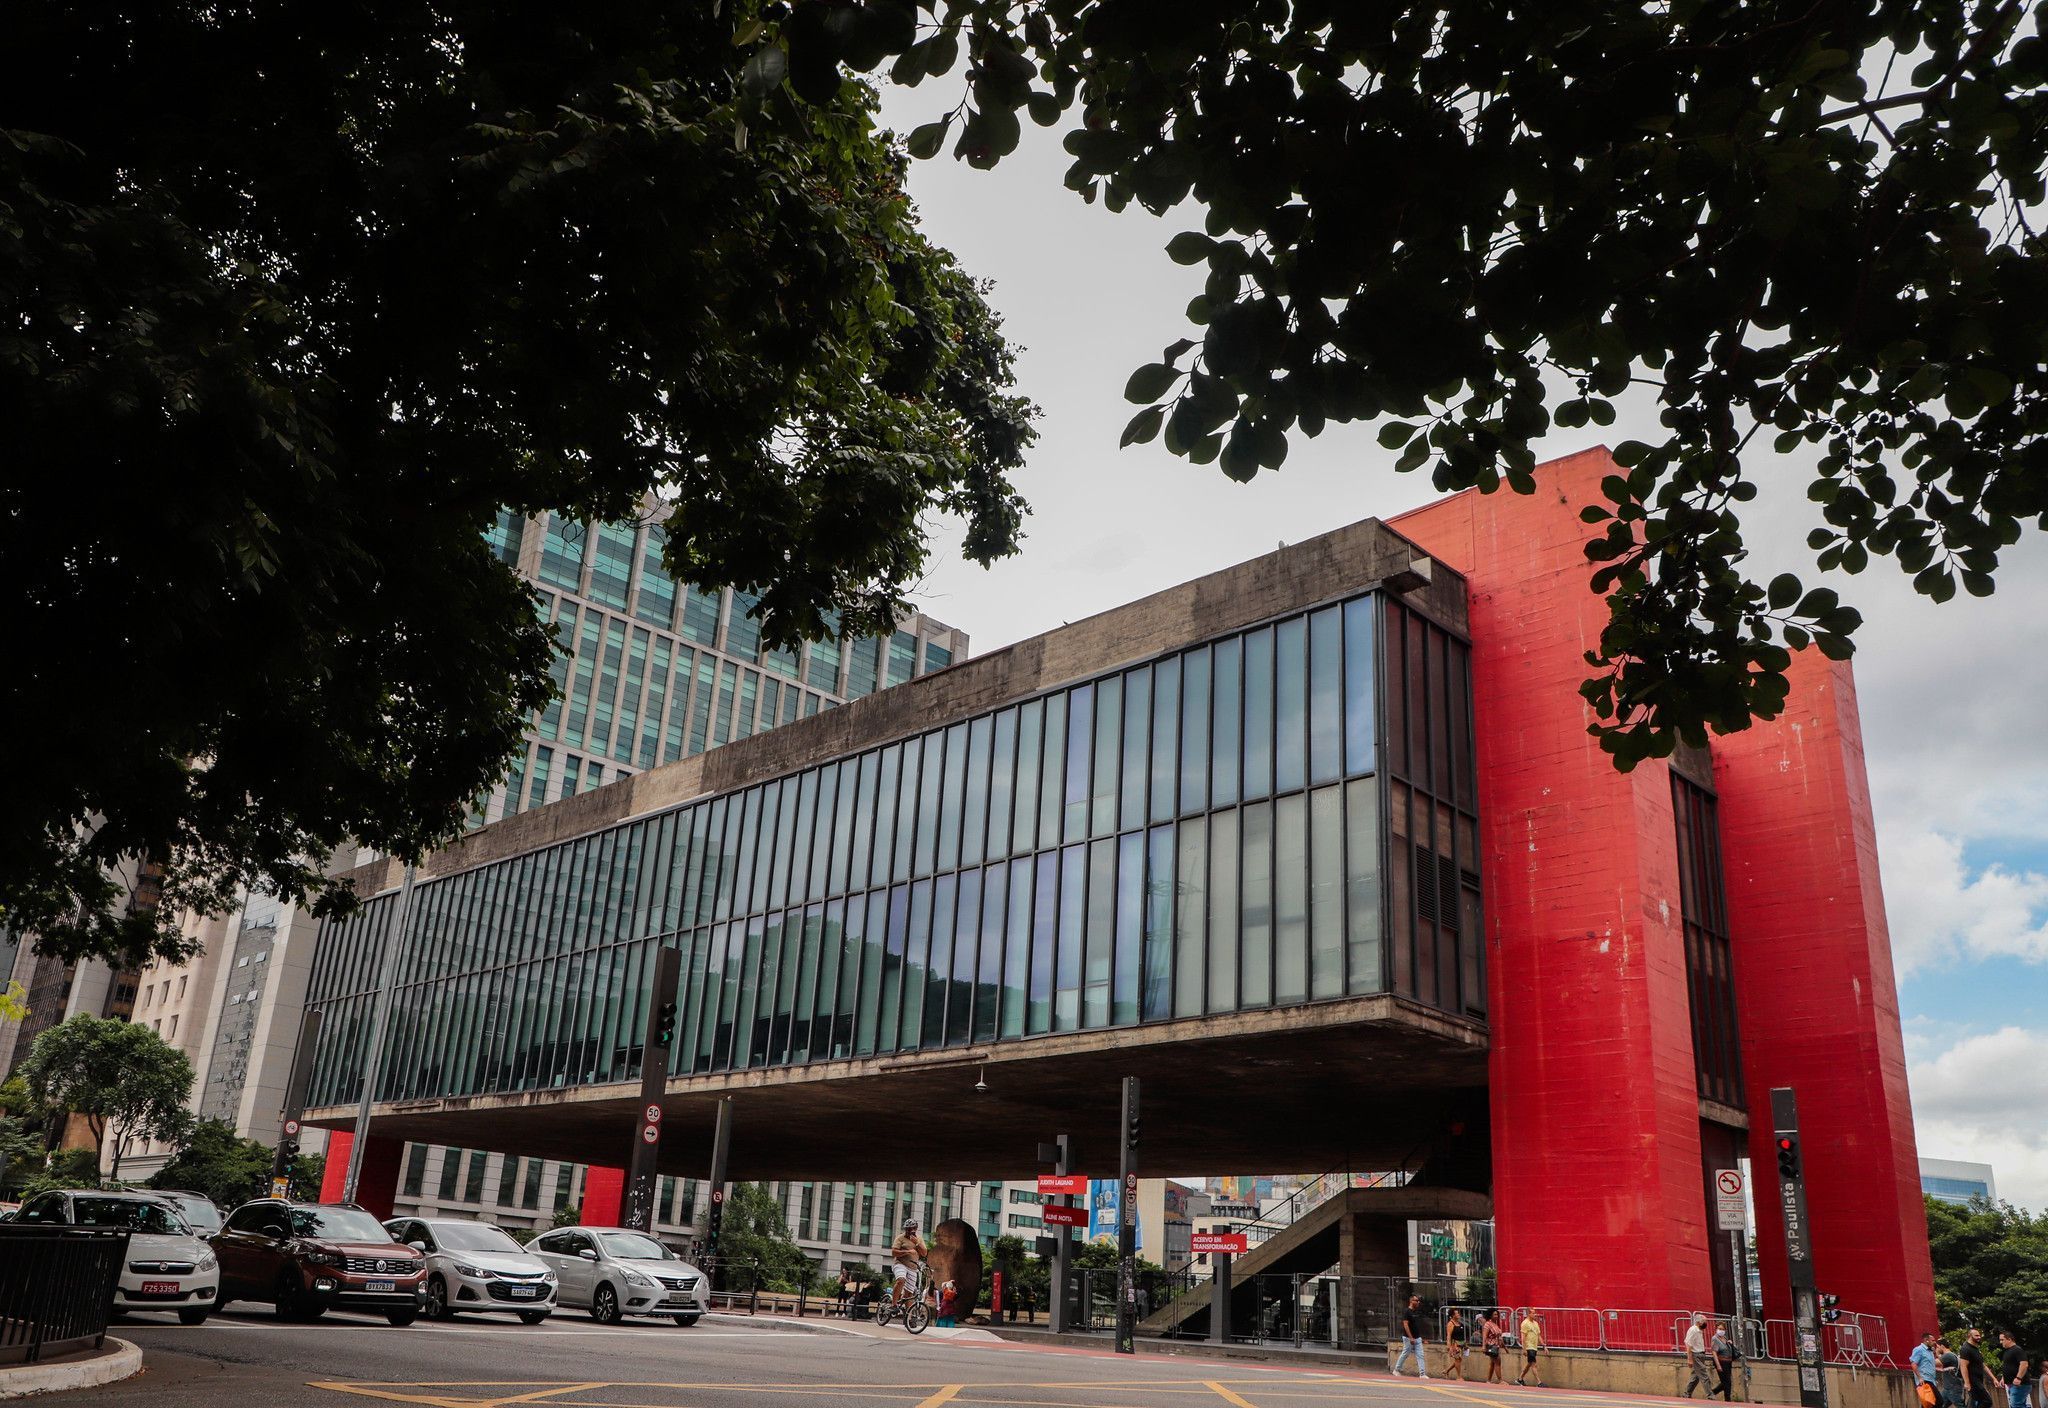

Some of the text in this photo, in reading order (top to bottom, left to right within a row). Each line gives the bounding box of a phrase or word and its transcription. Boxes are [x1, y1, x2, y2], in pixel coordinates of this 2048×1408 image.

[649, 1108, 659, 1118] 50
[1783, 1182, 1801, 1261] Av. Paulista
[1193, 1243, 1239, 1251] TRANSFORMAÇÃO
